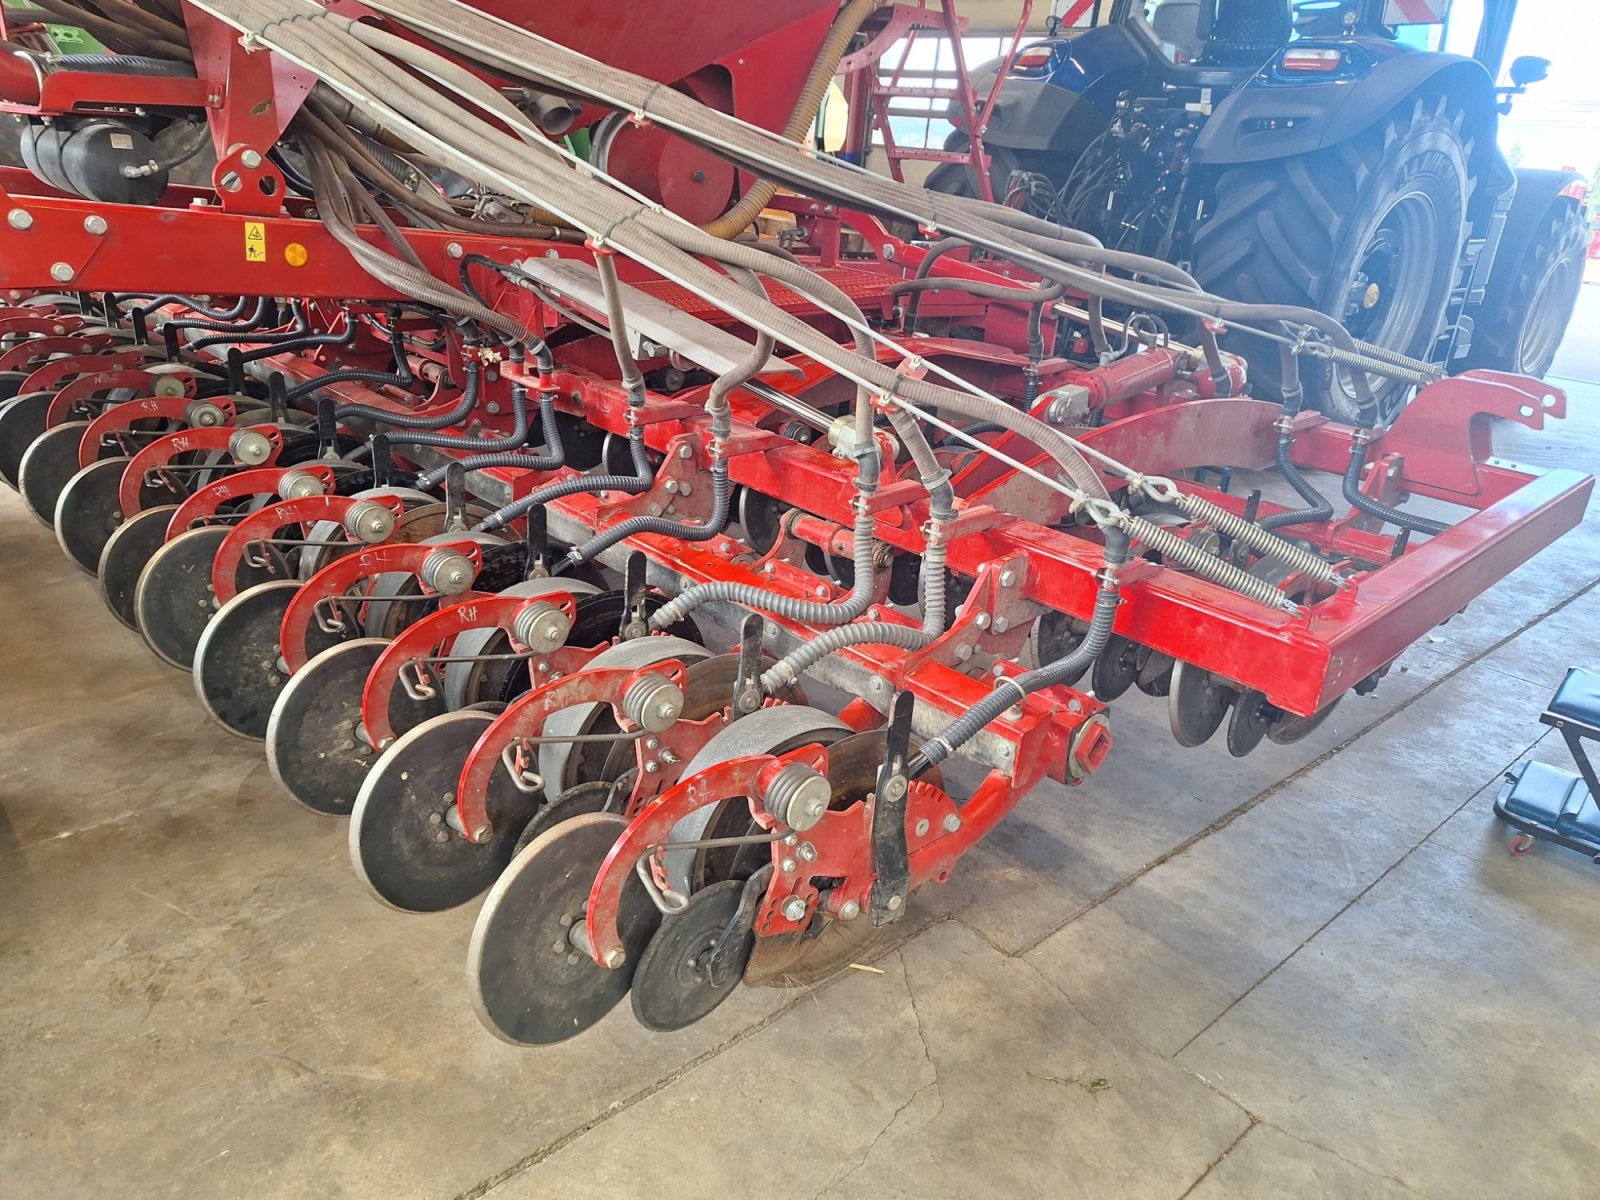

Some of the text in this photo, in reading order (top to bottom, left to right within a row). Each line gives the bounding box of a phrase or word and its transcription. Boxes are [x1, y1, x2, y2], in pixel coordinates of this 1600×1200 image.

[171, 436, 189, 452] RH
[212, 484, 232, 498] RH
[457, 605, 478, 624] RH
